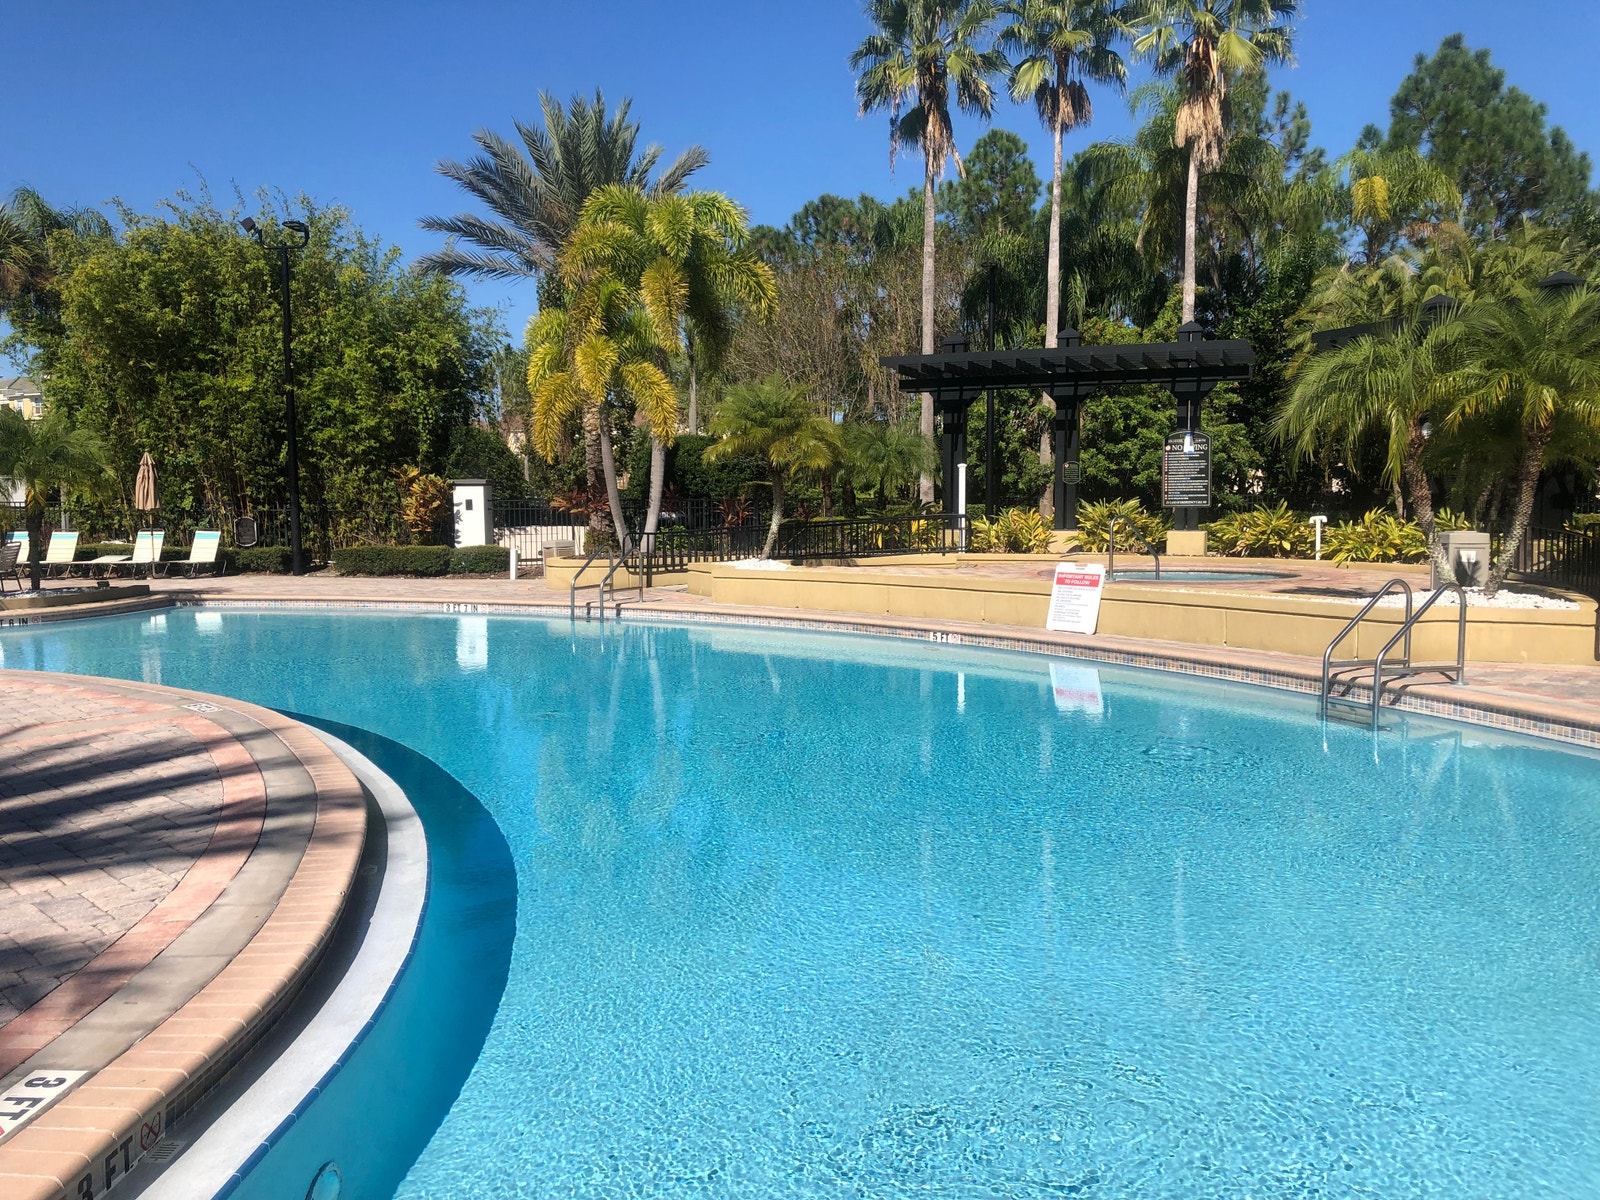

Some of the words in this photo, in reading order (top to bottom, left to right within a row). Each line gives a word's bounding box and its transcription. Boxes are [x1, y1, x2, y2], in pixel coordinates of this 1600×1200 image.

[932, 632, 938, 641] 5
[24, 1076, 67, 1089] 3
[0, 1096, 46, 1121] FT
[78, 1172, 94, 1200] 3
[104, 1134, 134, 1191] FT
